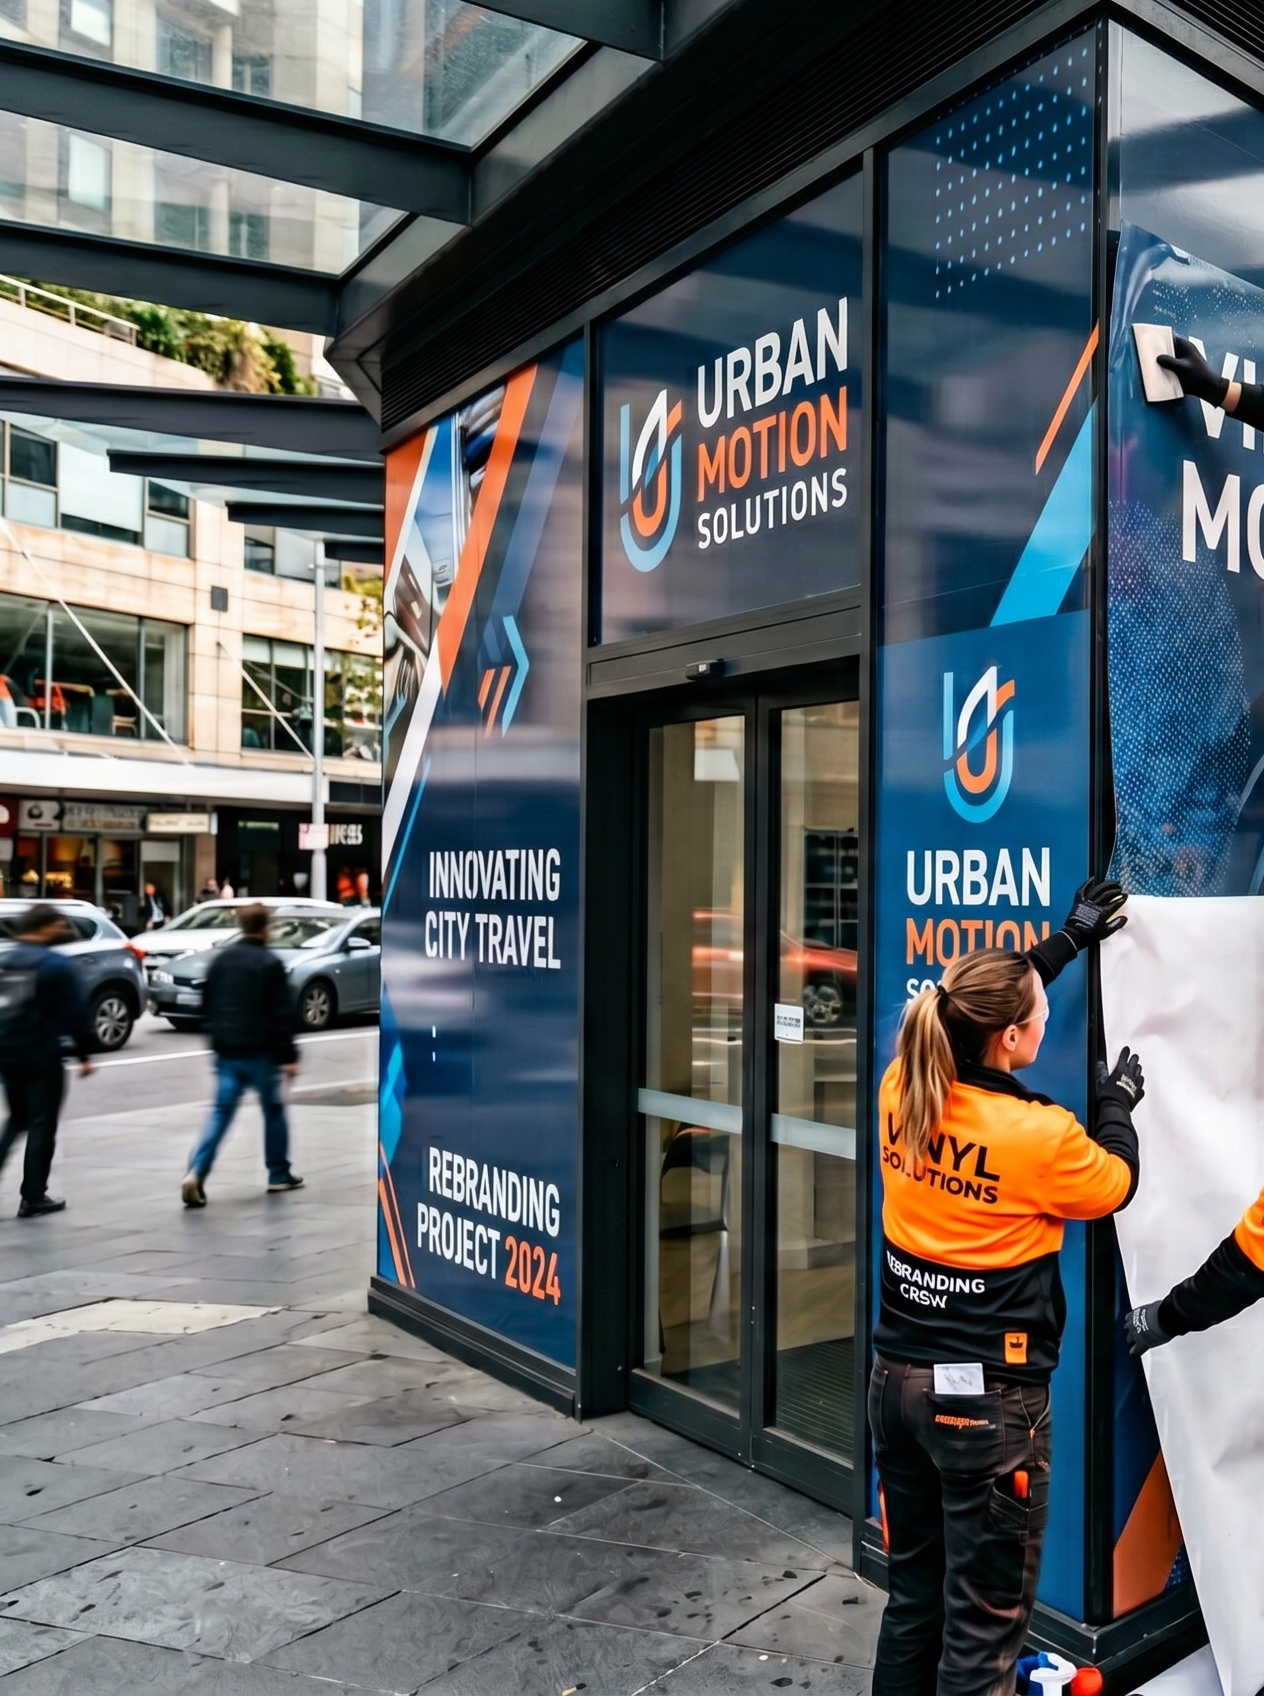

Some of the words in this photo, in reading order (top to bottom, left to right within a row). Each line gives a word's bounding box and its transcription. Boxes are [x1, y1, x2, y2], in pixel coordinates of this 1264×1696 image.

[697, 296, 848, 428] URBAN
[697, 385, 848, 502] MOTION
[697, 467, 848, 549] SOLUTIONS
[428, 848, 562, 901] INNOVATING
[906, 847, 1050, 907] URBAN
[424, 910, 470, 961] CITY
[474, 913, 561, 969] TRAVEL
[888, 1111, 1001, 1182] VNYL
[428, 1146, 561, 1238] REBRANDING
[416, 1202, 501, 1280] PROJECT
[505, 1235, 561, 1306] 2024
